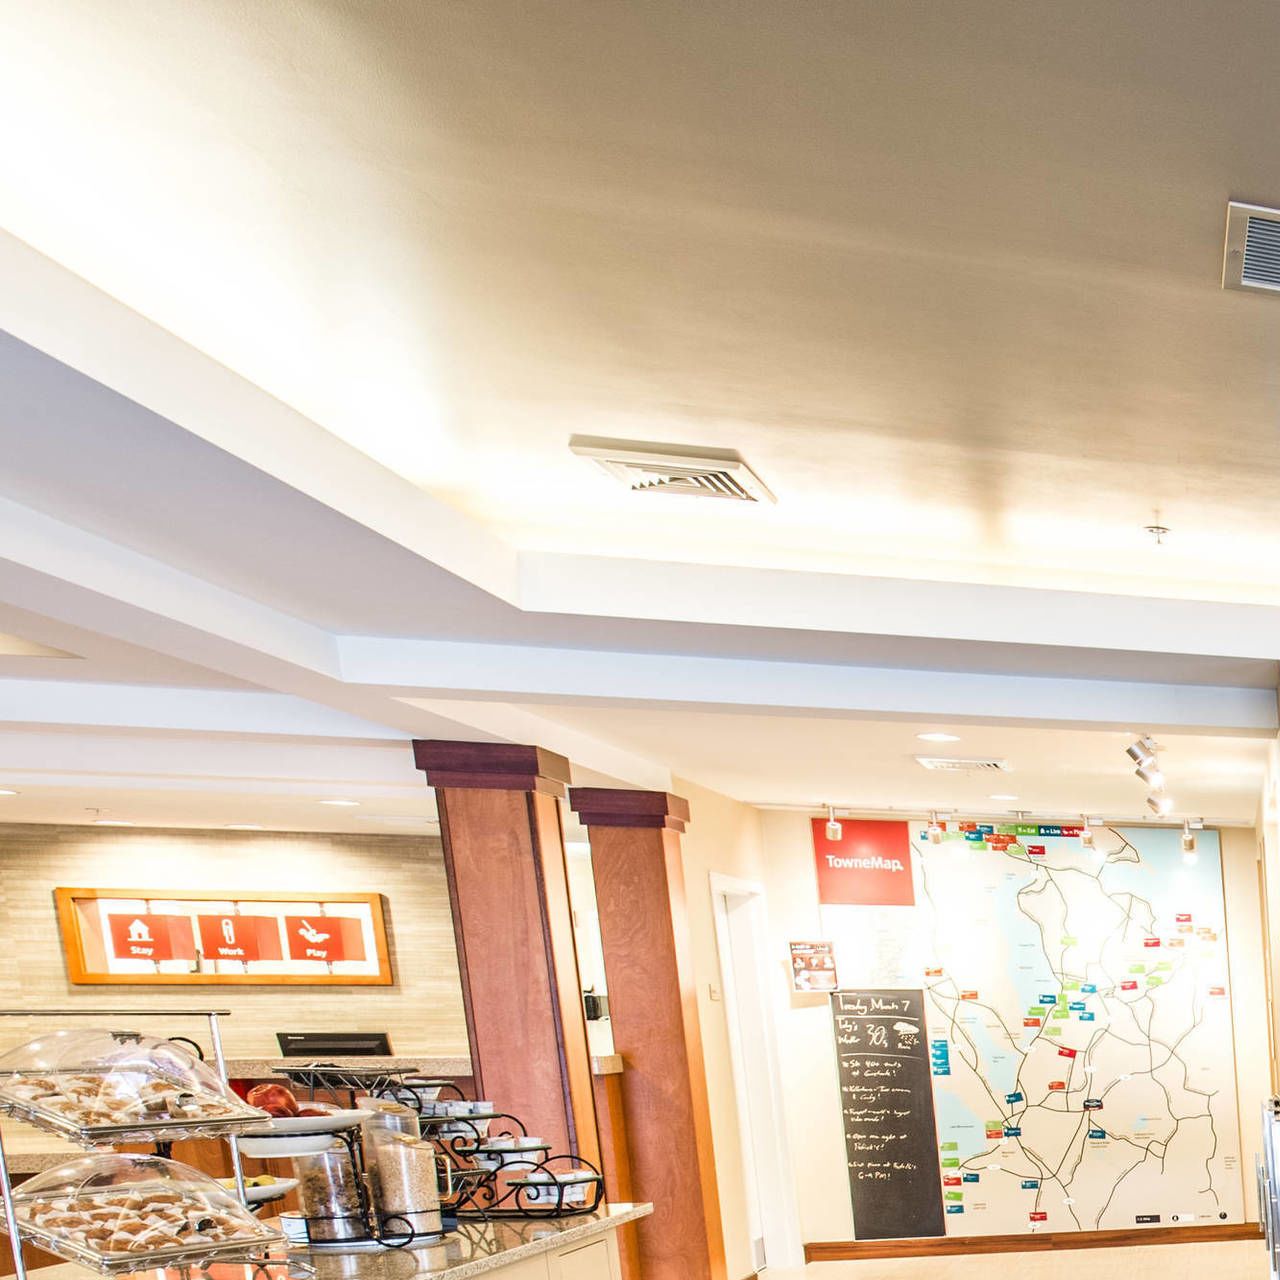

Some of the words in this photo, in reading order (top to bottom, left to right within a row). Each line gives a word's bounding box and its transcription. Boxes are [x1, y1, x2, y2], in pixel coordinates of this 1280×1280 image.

[130, 945, 154, 956] Stay
[217, 946, 245, 956] Work
[306, 948, 327, 959] Play
[901, 1000, 910, 1012] 7
